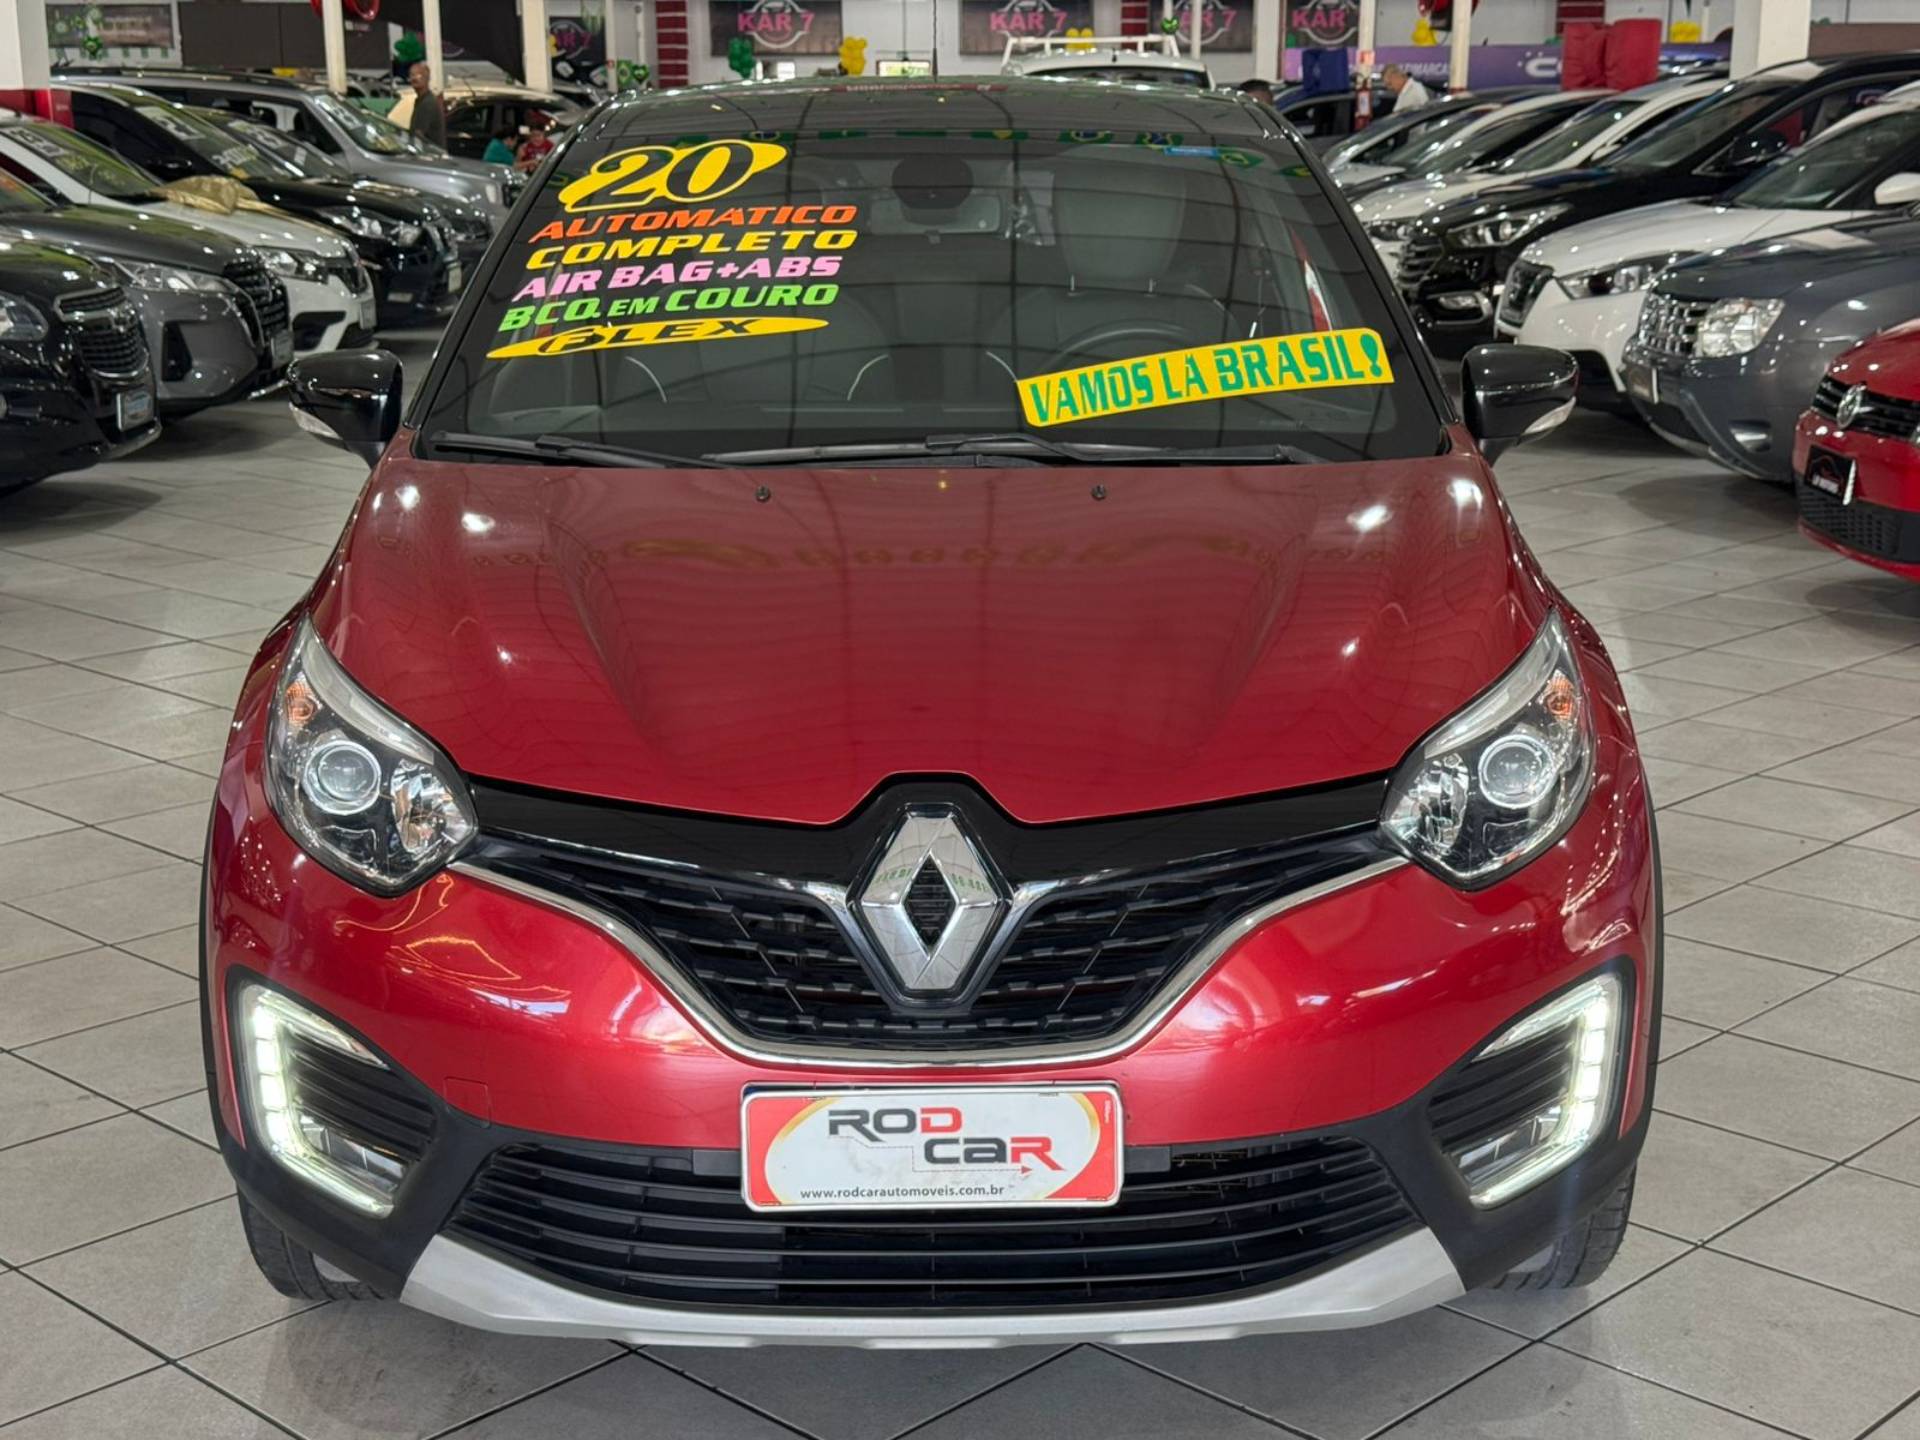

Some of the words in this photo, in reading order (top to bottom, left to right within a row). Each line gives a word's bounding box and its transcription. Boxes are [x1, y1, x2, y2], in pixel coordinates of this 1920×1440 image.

[738, 12, 792, 32] KAR
[800, 12, 815, 32] 7
[990, 12, 1045, 31] KAR
[1054, 11, 1068, 31] 7
[1222, 10, 1237, 31] 7
[1291, 9, 1345, 30] KAR
[567, 141, 757, 210] 20
[525, 230, 858, 271] COMPLETO
[511, 269, 602, 302] AIR
[607, 256, 842, 289] BAG+ABS
[608, 296, 660, 317] EM
[665, 284, 839, 312] COURO
[538, 318, 759, 356] FLEX
[1029, 362, 1154, 423] VAMOS
[1160, 354, 1208, 400] LA
[1213, 333, 1384, 391] BRASIL!
[828, 1107, 962, 1142] ROD
[799, 1183, 1006, 1200] www.rodcarautomoveis.com.br
